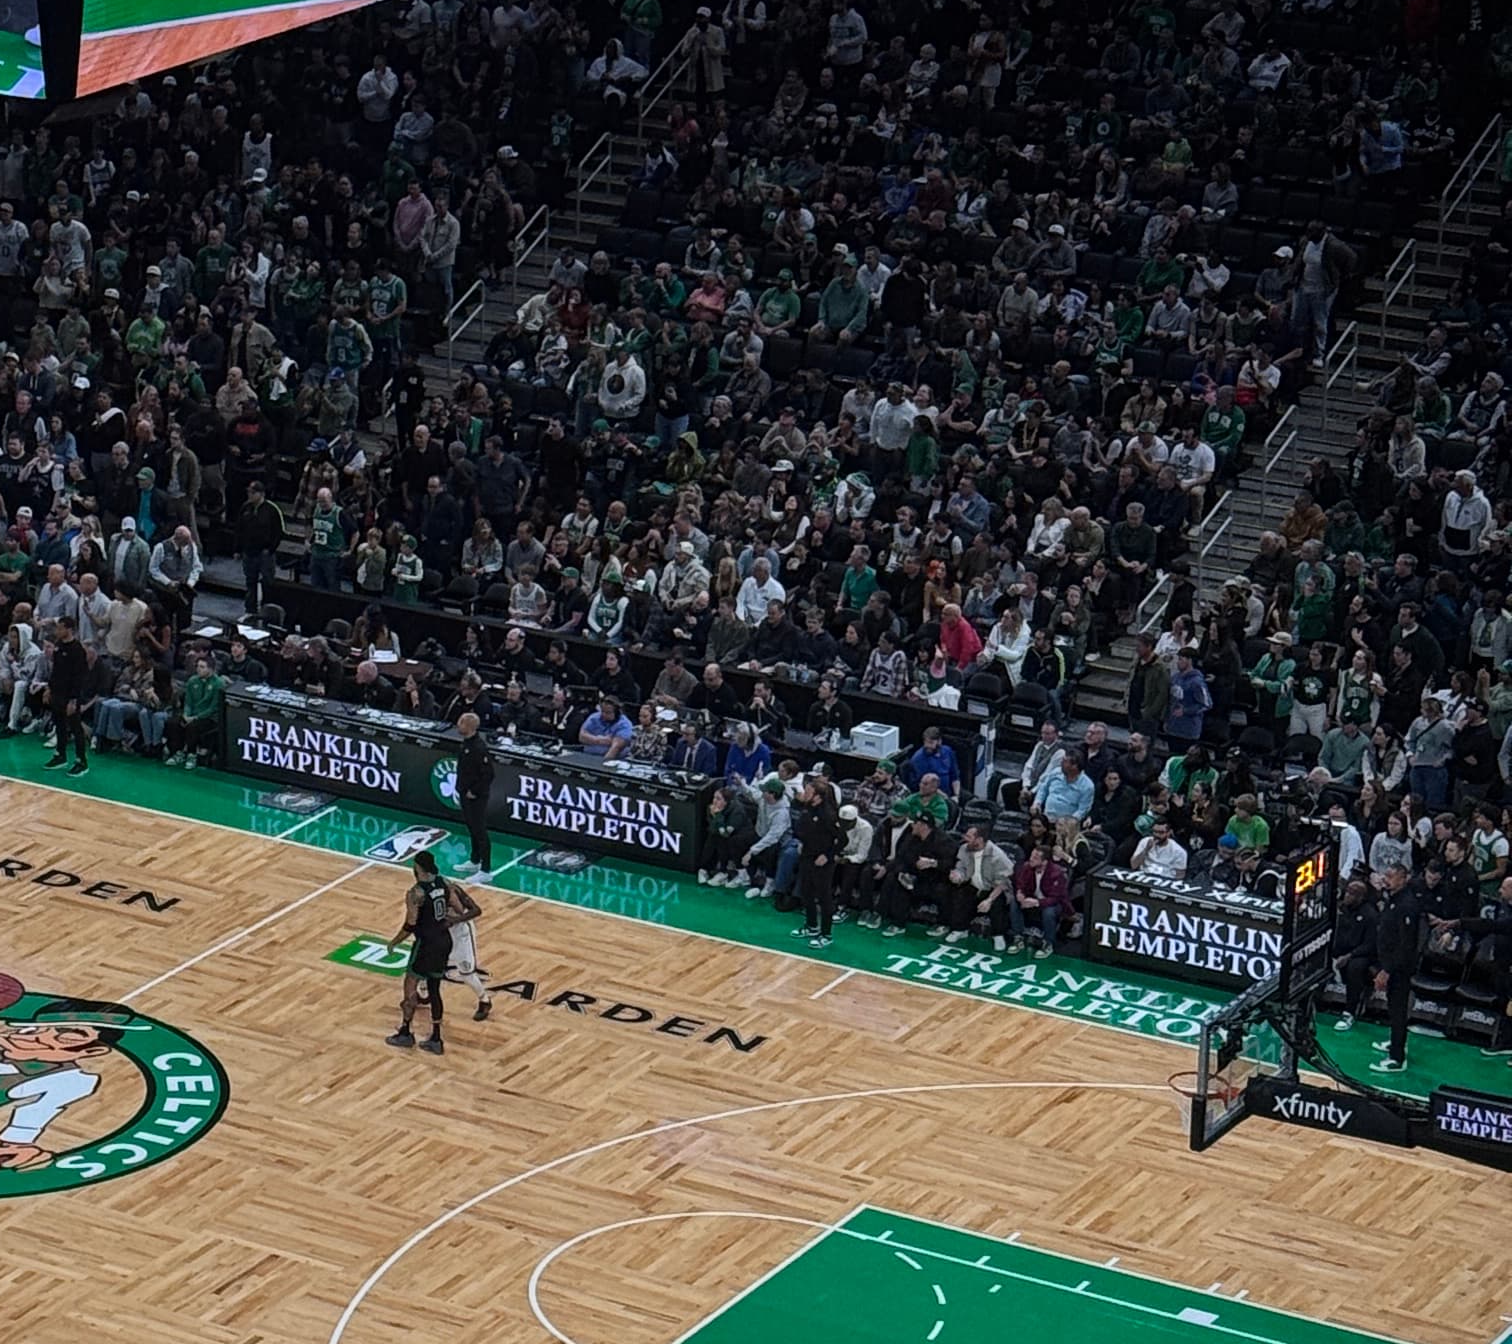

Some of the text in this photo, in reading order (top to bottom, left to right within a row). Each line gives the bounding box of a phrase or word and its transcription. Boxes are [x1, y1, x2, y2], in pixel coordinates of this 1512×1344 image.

[238, 738, 401, 794] TEMPLETON
[248, 716, 390, 767] FRANKLIN
[506, 797, 682, 854] TEMPLETON
[519, 774, 670, 827] FRANKLIN
[1106, 868, 1202, 894] xfinity
[1095, 922, 1281, 981] TEMPLETO
[1109, 898, 1283, 957] FRANKLIN
[882, 955, 1202, 1038] TEMPLETO
[55, 1051, 215, 1180] CELTICS
[1272, 1092, 1353, 1129] xfinity
[1445, 1101, 1512, 1129] FRANK
